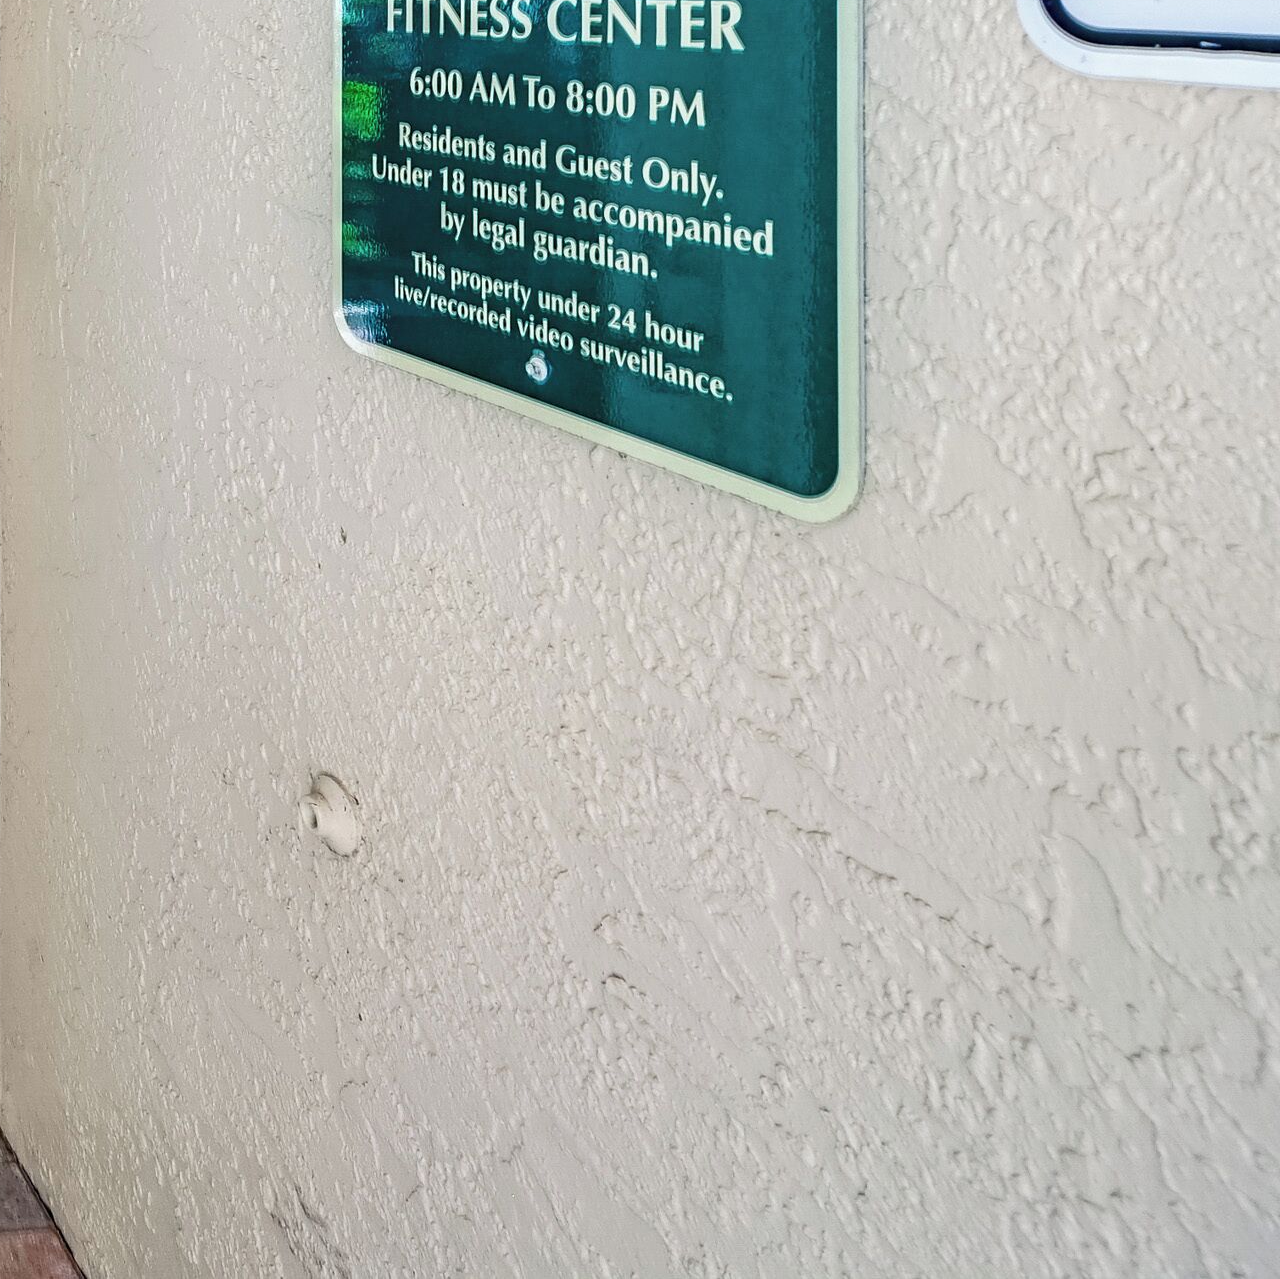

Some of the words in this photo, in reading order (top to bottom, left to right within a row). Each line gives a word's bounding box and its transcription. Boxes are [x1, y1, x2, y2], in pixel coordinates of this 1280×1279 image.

[409, 66, 463, 99] 6:00
[469, 71, 516, 106] AM
[523, 75, 556, 110] To
[566, 80, 637, 118] 8:00
[648, 85, 707, 127] PM
[371, 154, 433, 188] Under
[439, 164, 465, 196] 18
[472, 177, 528, 209] must
[535, 180, 565, 215] be
[573, 196, 775, 256] accompanied
[398, 121, 495, 162] Residents
[502, 140, 548, 172] and
[555, 145, 633, 184] Guest
[642, 156, 724, 207] Only.
[440, 202, 465, 241] by
[472, 208, 525, 251] legal
[533, 228, 658, 279] guardian.
[394, 278, 512, 333] live/recorded
[518, 315, 574, 351] video
[579, 338, 733, 402] surveillance.
[411, 251, 446, 280] This
[450, 268, 531, 310] property
[538, 291, 599, 324] under
[607, 304, 637, 333] 24
[645, 312, 704, 352] hour
